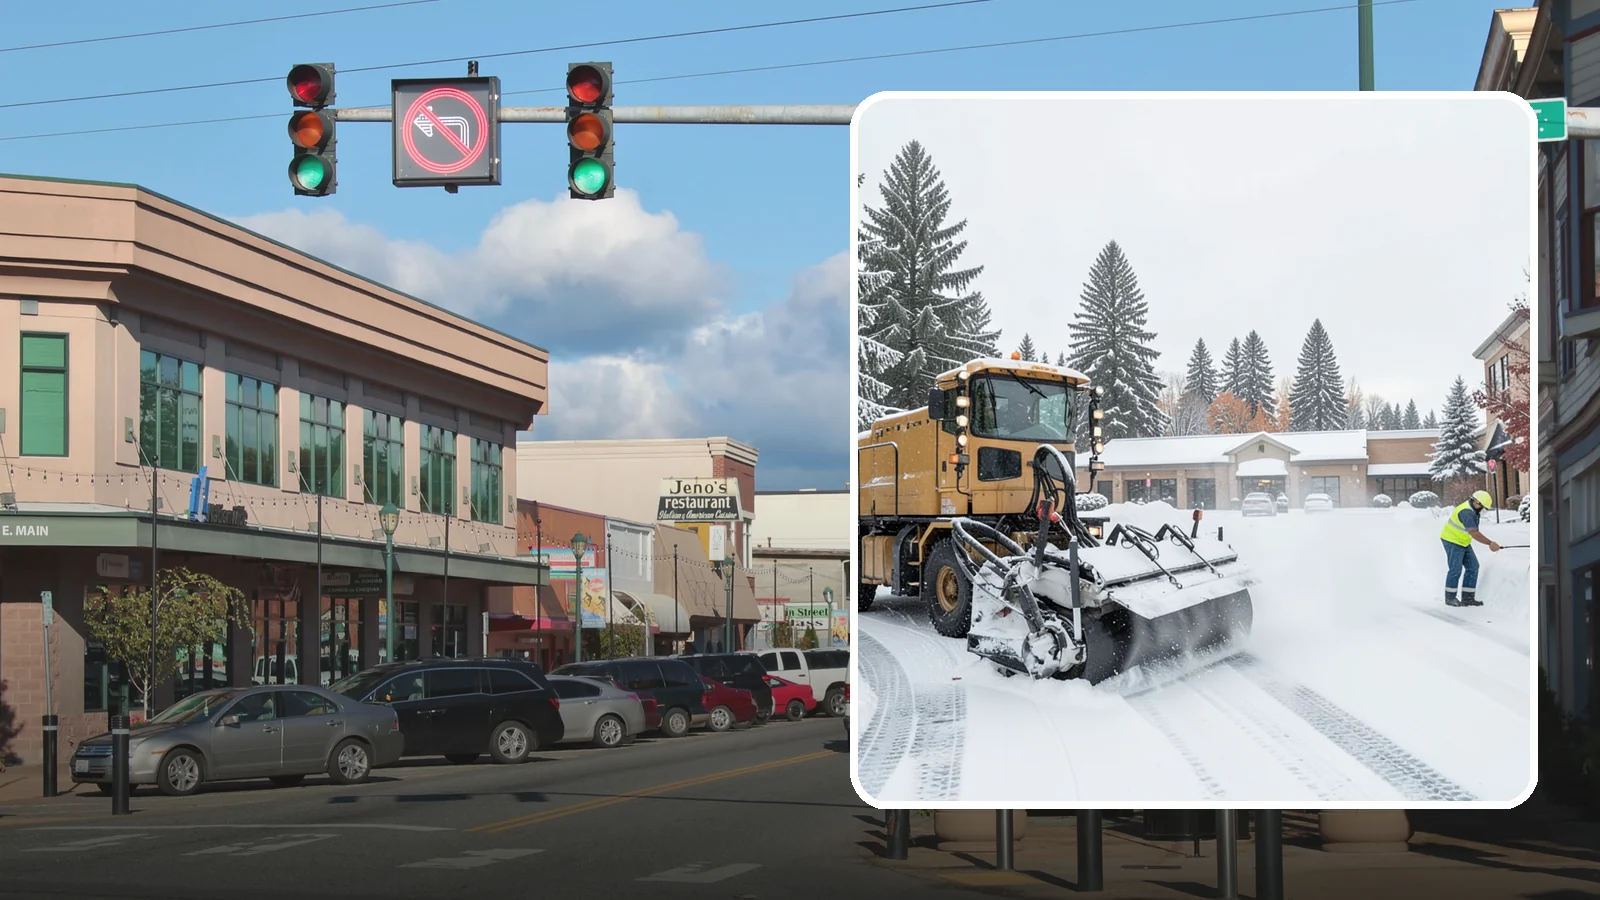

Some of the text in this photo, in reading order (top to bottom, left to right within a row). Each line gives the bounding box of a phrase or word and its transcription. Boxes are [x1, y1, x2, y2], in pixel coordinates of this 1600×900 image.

[669, 479, 728, 494] Jeno's
[665, 496, 731, 509] restaurant
[2, 525, 49, 537] E. MAIN
